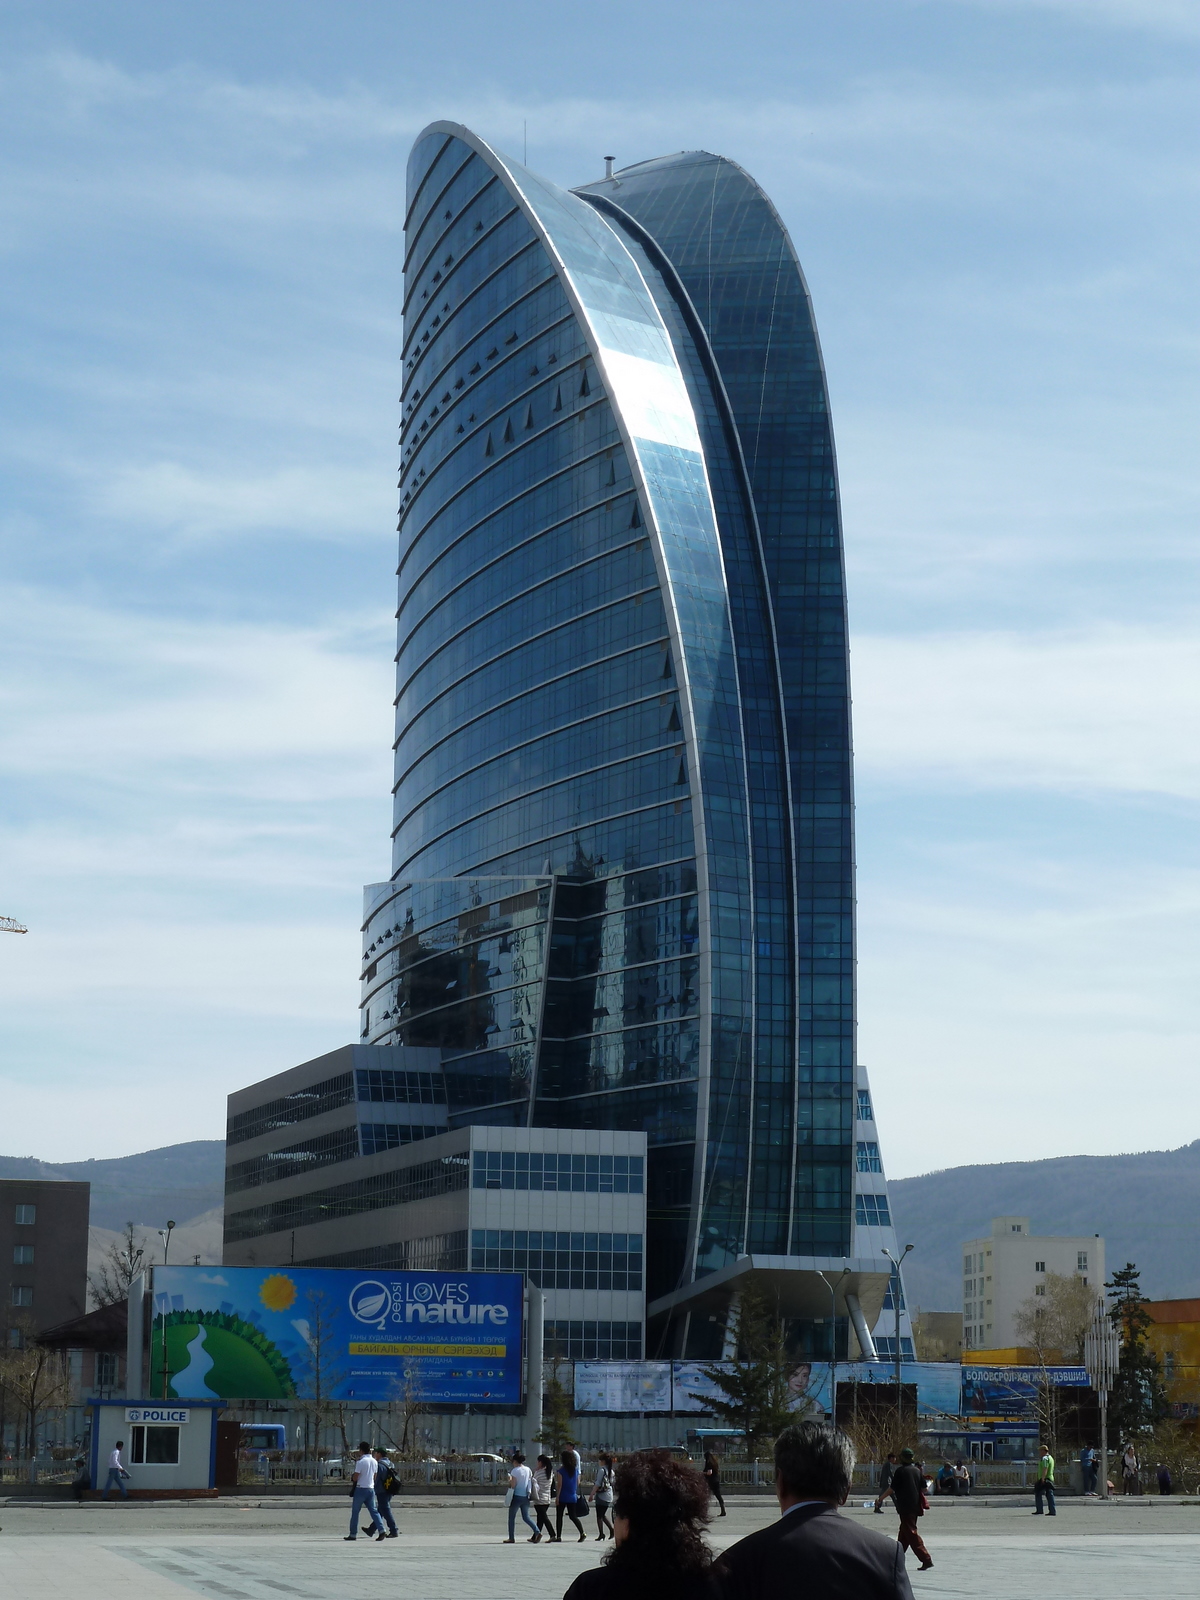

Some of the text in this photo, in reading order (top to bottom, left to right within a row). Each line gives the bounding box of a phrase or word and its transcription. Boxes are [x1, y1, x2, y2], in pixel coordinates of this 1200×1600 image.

[391, 1282, 404, 1323] pepsi
[405, 1282, 469, 1303] LOVES
[405, 1299, 509, 1325] nature
[357, 1344, 497, 1356] БАЙГАЛЬ ОРЧНЫГ СЭРГЭЭХЭД
[143, 1411, 186, 1421] POLICE
